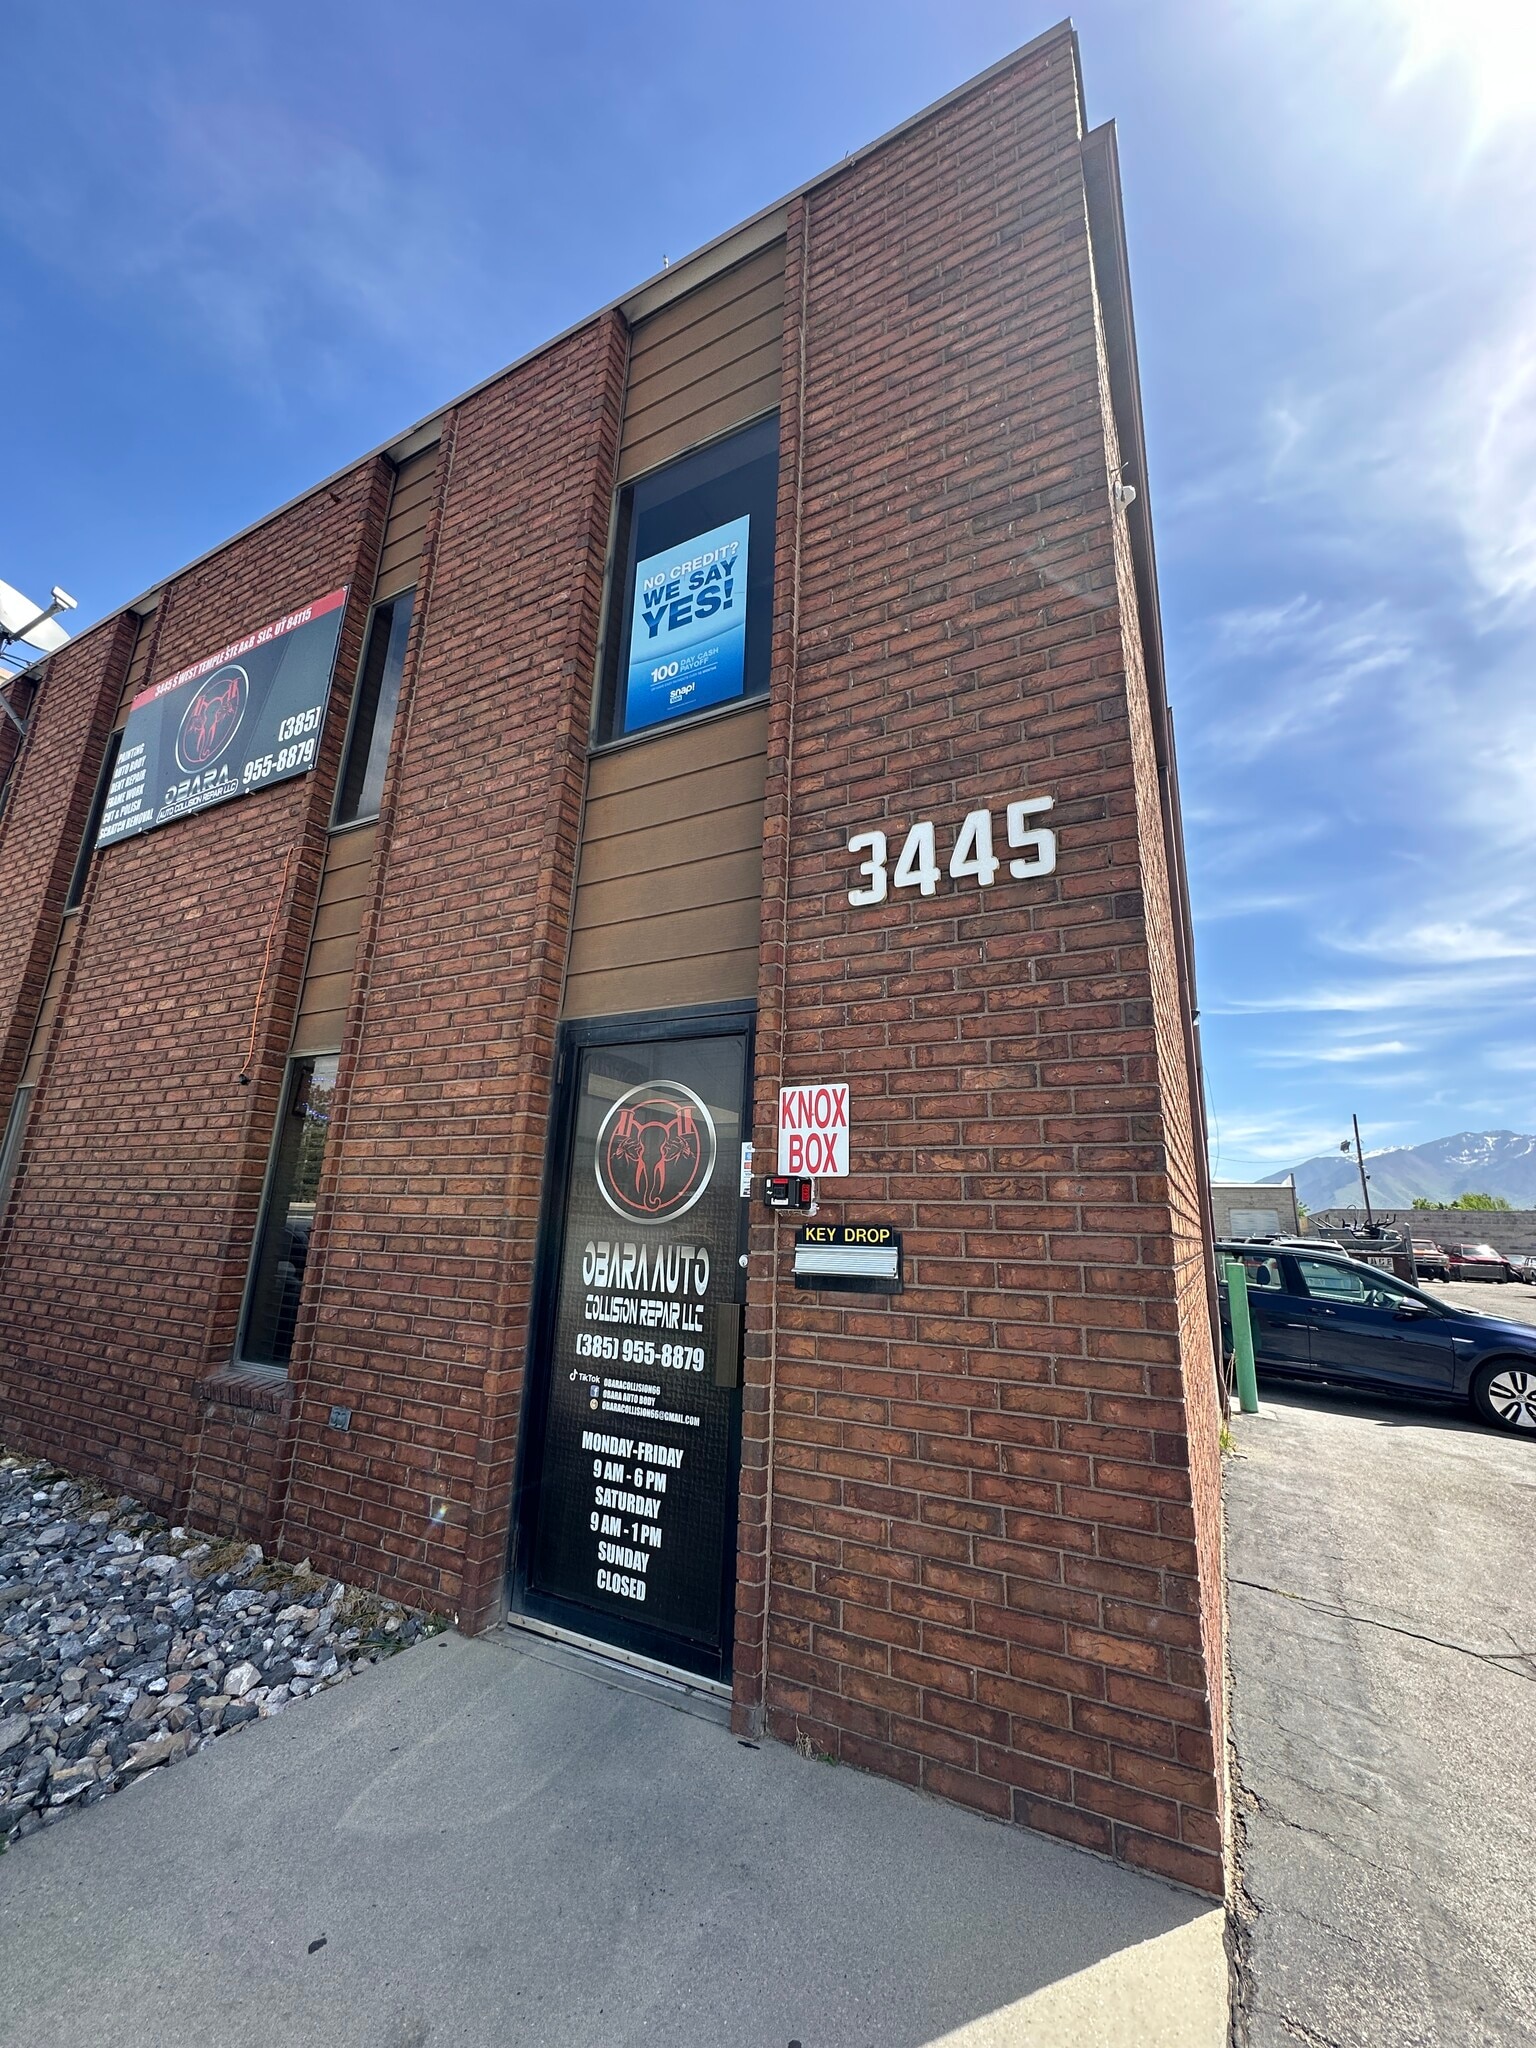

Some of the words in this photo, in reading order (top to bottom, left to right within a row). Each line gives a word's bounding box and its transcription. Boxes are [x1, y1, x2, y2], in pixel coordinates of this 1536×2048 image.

[643, 572, 666, 591] NO
[669, 541, 739, 580] CREDIT?
[643, 579, 681, 609] WE
[688, 554, 739, 591] SAY
[641, 577, 735, 639] YES!
[178, 666, 198, 684] WEST
[198, 652, 225, 674] TEMPLE
[224, 644, 240, 661] STE
[274, 619, 287, 636] UT
[287, 607, 312, 630] 84115
[651, 661, 679, 683] 100
[680, 656, 695, 666] DAY
[697, 647, 719, 660] CASH
[680, 657, 709, 672] PAYOFF
[670, 682, 695, 698] snap!
[278, 706, 321, 741] (385)
[125, 769, 147, 788] REPAIR
[242, 738, 315, 785] 955-8879
[159, 806, 174, 820] AUTO
[202, 787, 223, 801] REPAIR
[223, 782, 236, 794] LLC
[165, 763, 229, 804] OBARA
[125, 808, 154, 829] REMOVAL
[848, 795, 1057, 907] 3445
[781, 1088, 847, 1130] KNOX
[788, 1133, 838, 1174] BOX
[805, 1227, 836, 1242] KEY
[844, 1228, 890, 1243] DROP
[582, 1240, 648, 1291] OBARA
[651, 1244, 710, 1296] AUTO
[639, 1299, 681, 1329] REPAIR
[682, 1303, 705, 1332] LLC
[576, 1333, 619, 1360] (385)
[622, 1338, 705, 1372] 955-8879
[579, 1372, 601, 1384] TikTok
[602, 1389, 622, 1401] OBARA
[622, 1392, 639, 1404] AUTO
[639, 1395, 656, 1407] BODY
[581, 1430, 684, 1469] MONDAY-FRIDAY
[592, 1459, 602, 1478] 9
[603, 1461, 625, 1483] AM
[634, 1467, 644, 1488] 6
[645, 1470, 667, 1493] PM
[594, 1485, 661, 1519] SATURDAY
[590, 1511, 600, 1531] 9
[600, 1514, 622, 1538] AM
[631, 1522, 639, 1542] 1
[640, 1524, 662, 1548] PM
[598, 1541, 650, 1573] SUNDAY
[596, 1568, 647, 1601] CLOSED
